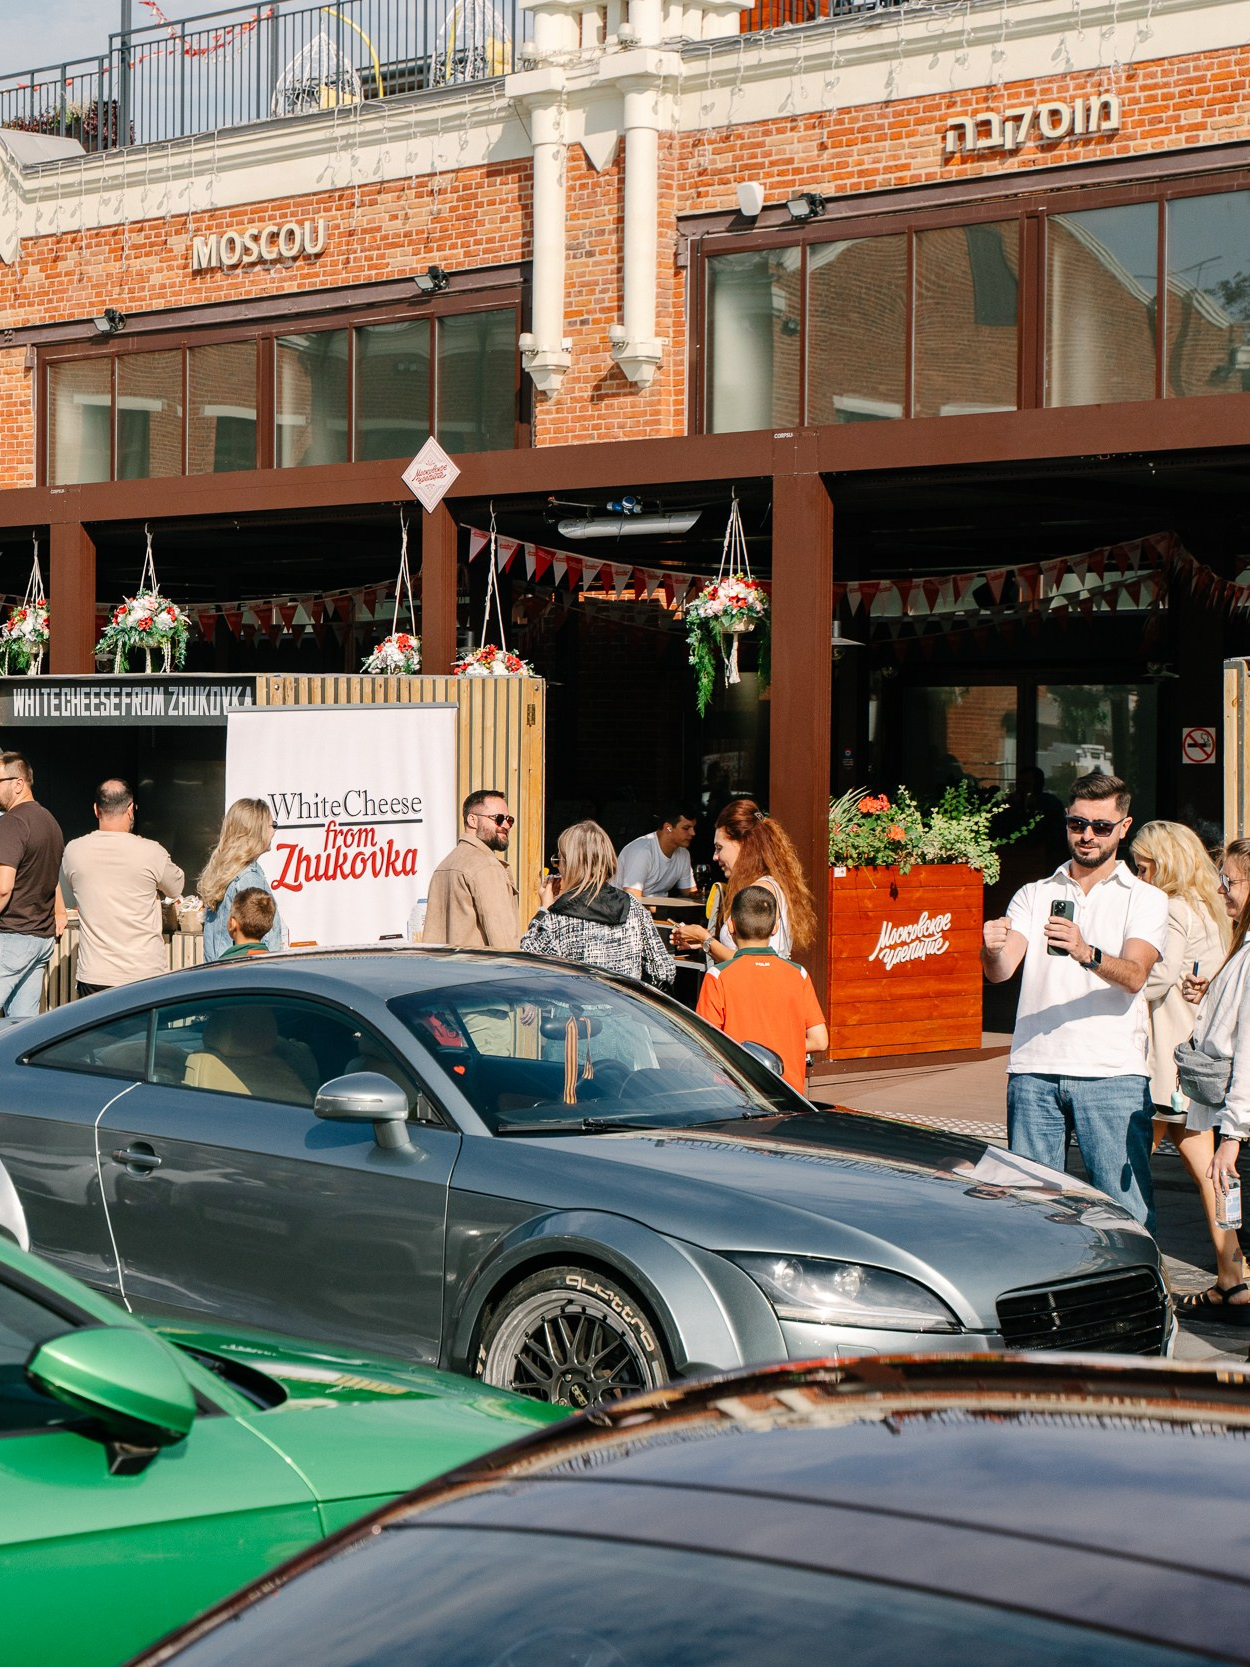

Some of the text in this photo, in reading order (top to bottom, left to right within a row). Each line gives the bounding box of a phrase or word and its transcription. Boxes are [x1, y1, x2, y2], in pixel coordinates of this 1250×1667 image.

[946, 94, 1121, 152] מוסקבה
[192, 218, 327, 270] MOSCOU
[323, 820, 377, 852] from
[271, 838, 419, 892] Zhukovka
[565, 1274, 655, 1352] quattro
